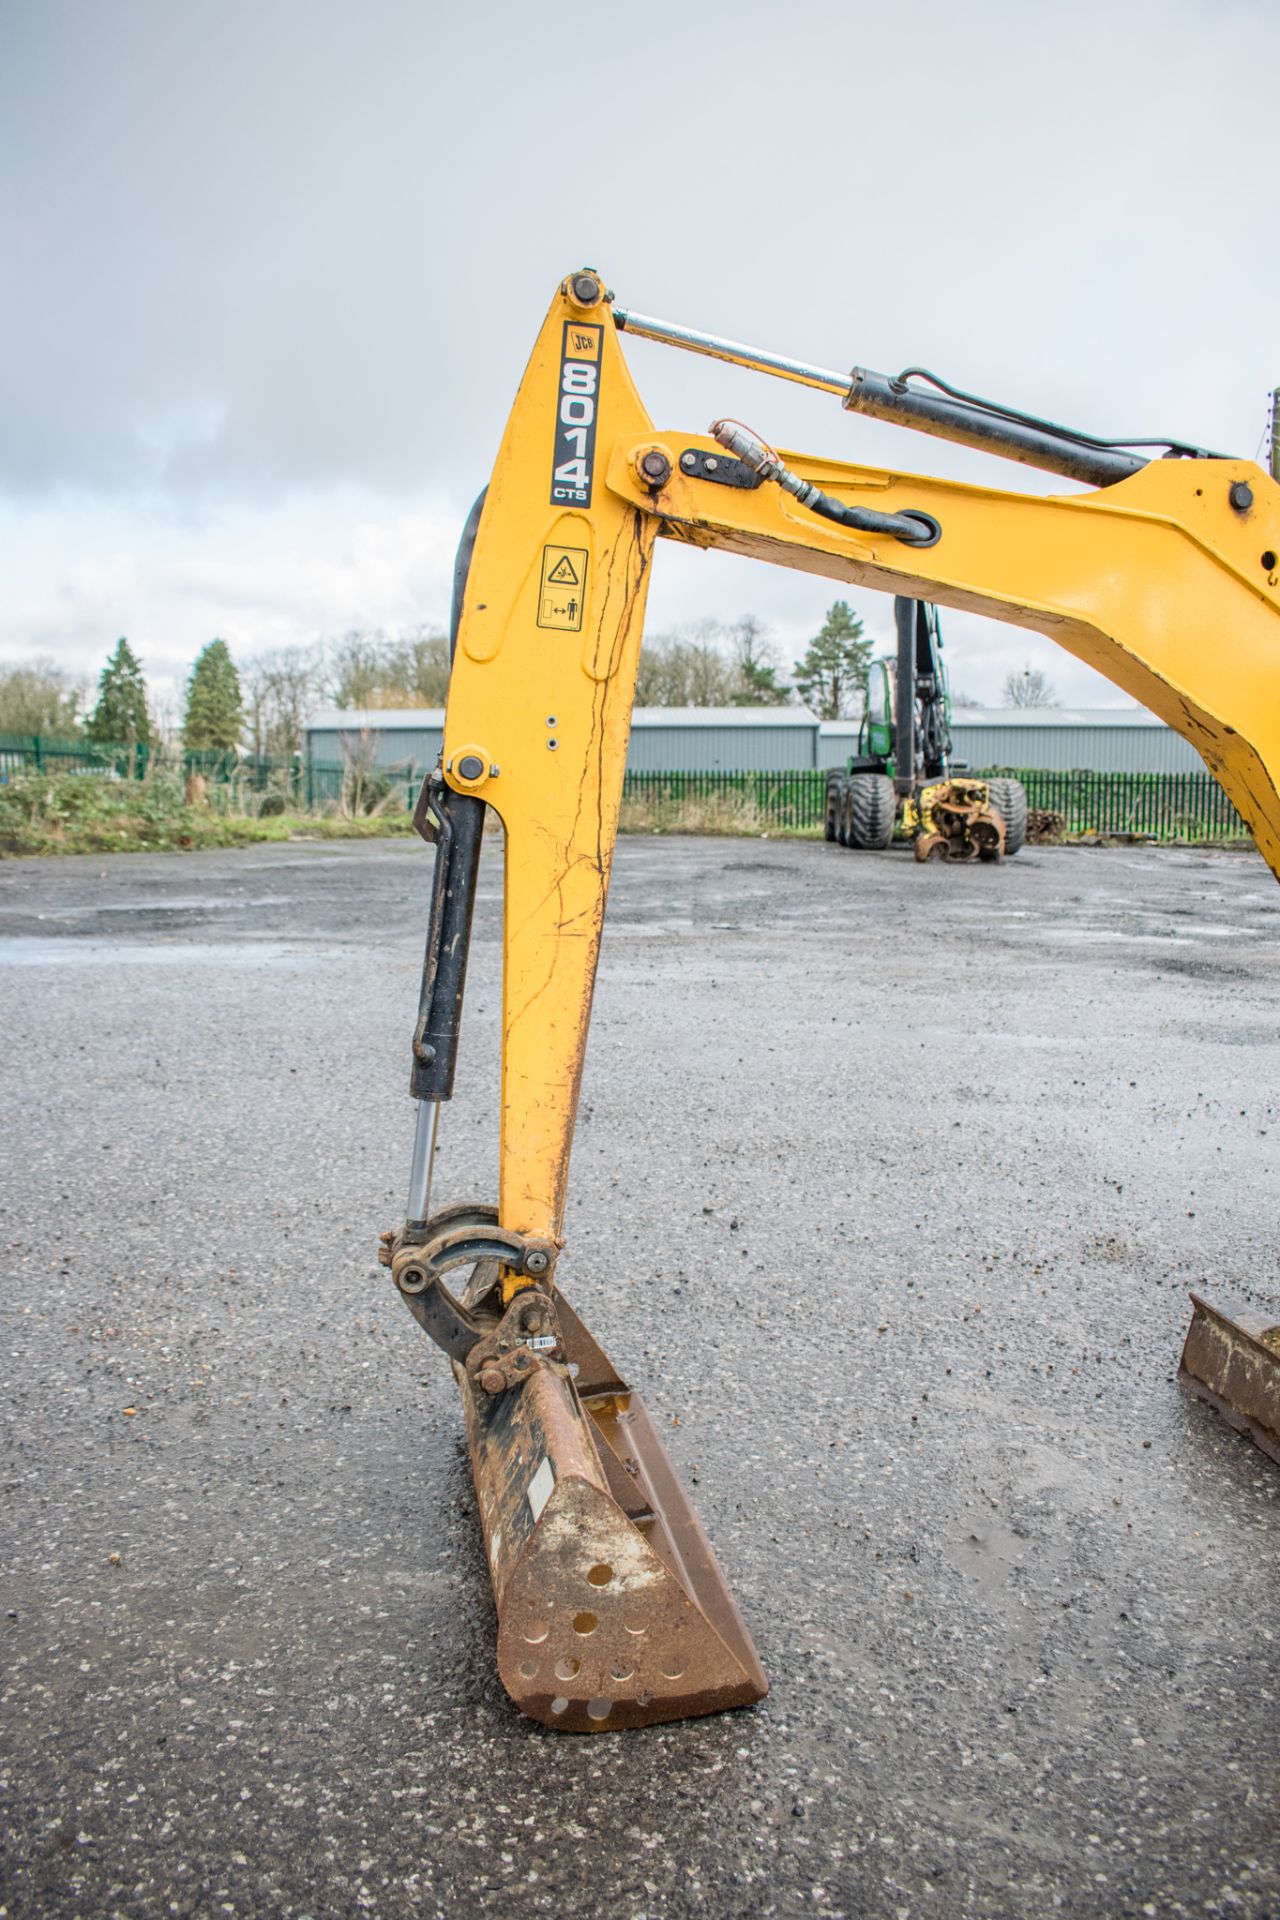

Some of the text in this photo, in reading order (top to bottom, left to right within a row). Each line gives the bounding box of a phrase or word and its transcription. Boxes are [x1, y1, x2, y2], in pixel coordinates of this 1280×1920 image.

[574, 333, 595, 351] JCB
[554, 362, 597, 489] 8014
[553, 488, 587, 500] CTS
